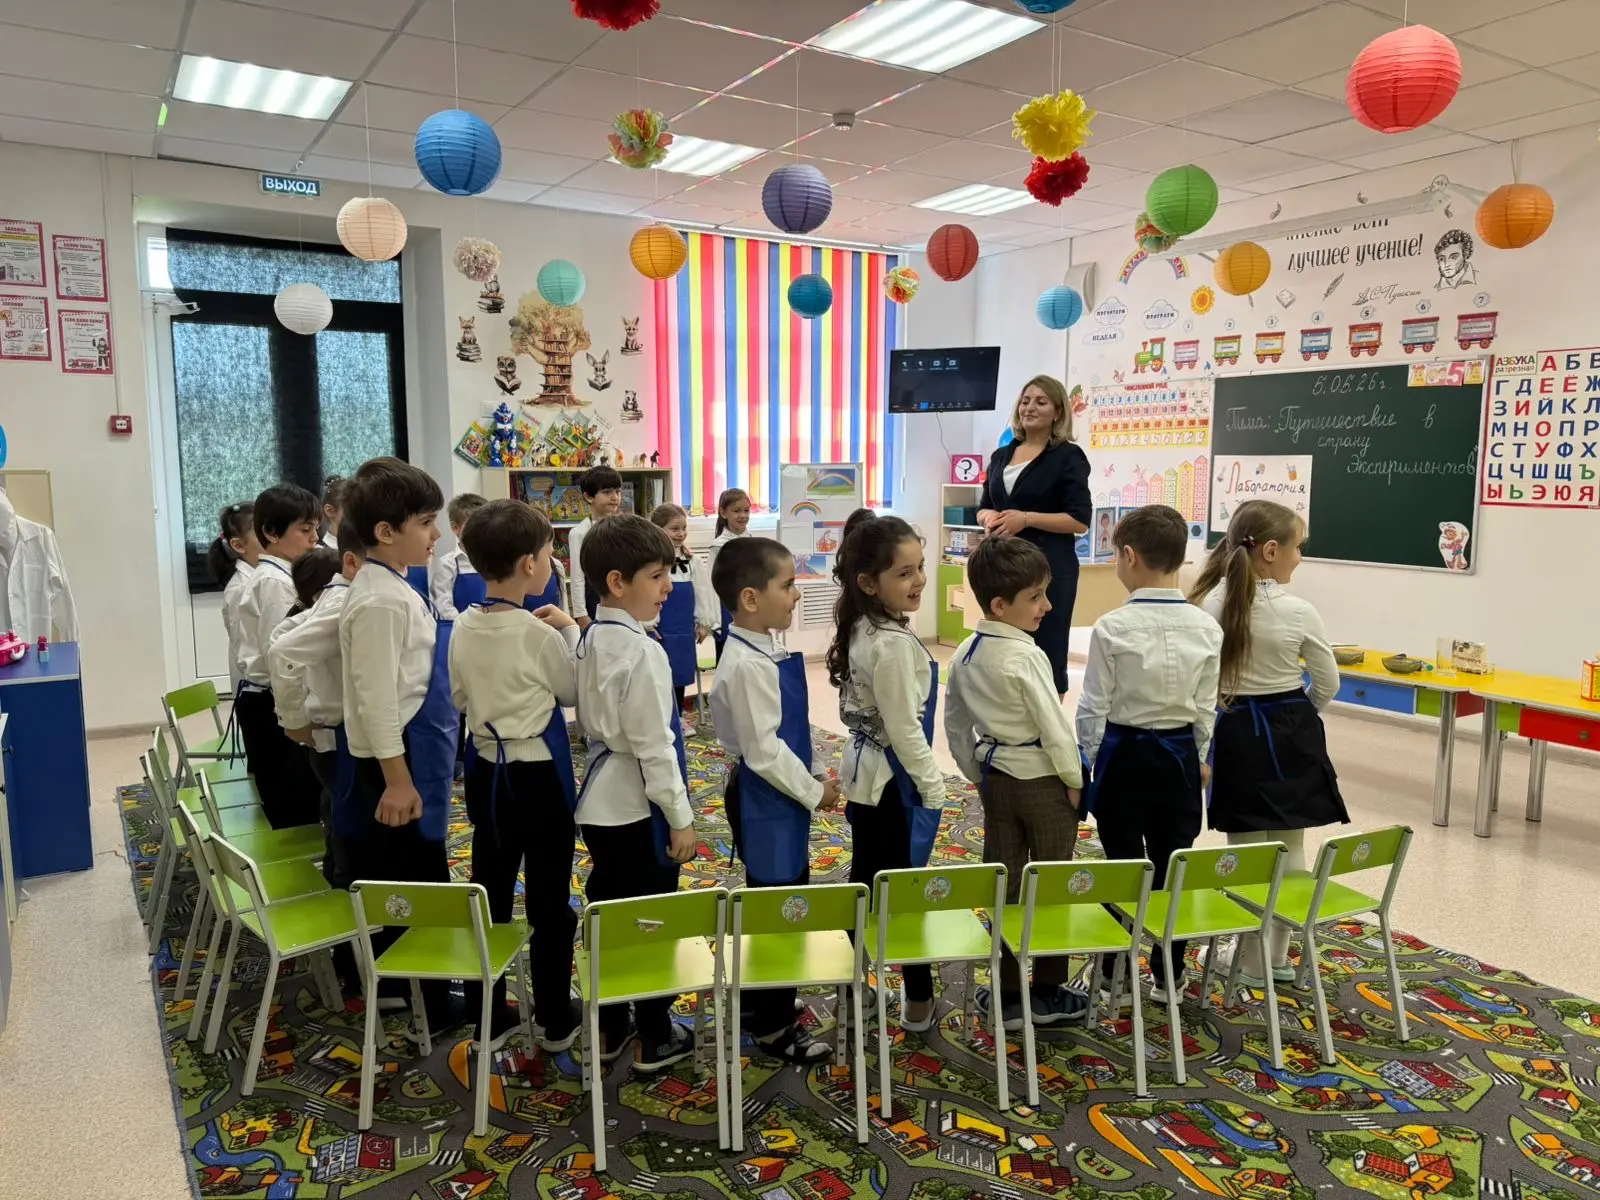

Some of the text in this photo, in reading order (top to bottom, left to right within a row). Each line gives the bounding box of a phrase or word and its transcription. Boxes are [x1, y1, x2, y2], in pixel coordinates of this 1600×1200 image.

[266, 177, 318, 194] ВЫХОД
[1287, 245, 1350, 273] лучшее
[1355, 233, 1424, 267] учение!
[20, 312, 46, 330] 112
[1496, 355, 1536, 366] АЗБУКА
[1541, 356, 1557, 372] А
[1566, 354, 1580, 370] Б
[1446, 362, 1465, 386] 5
[1495, 366, 1535, 374] разрезная
[1496, 380, 1509, 396] Г
[1515, 378, 1532, 396] Д
[1540, 378, 1555, 394] Е
[1563, 374, 1578, 393] Ё
[1493, 401, 1507, 416] З
[1515, 400, 1530, 416] И
[1538, 398, 1552, 415] Й
[1562, 398, 1577, 414] К
[1423, 404, 1436, 429] в
[1491, 420, 1600, 437] М Н О П Р
[1318, 436, 1372, 457] страну
[1490, 442, 1598, 458] С Т У Ф Х
[961, 459, 972, 480] ?
[1225, 461, 1306, 496] Лаборатория
[1488, 463, 1595, 481] Ц Ч Ш Щ Ъ
[1487, 484, 1594, 502] Ы Ь Э Ю Я
